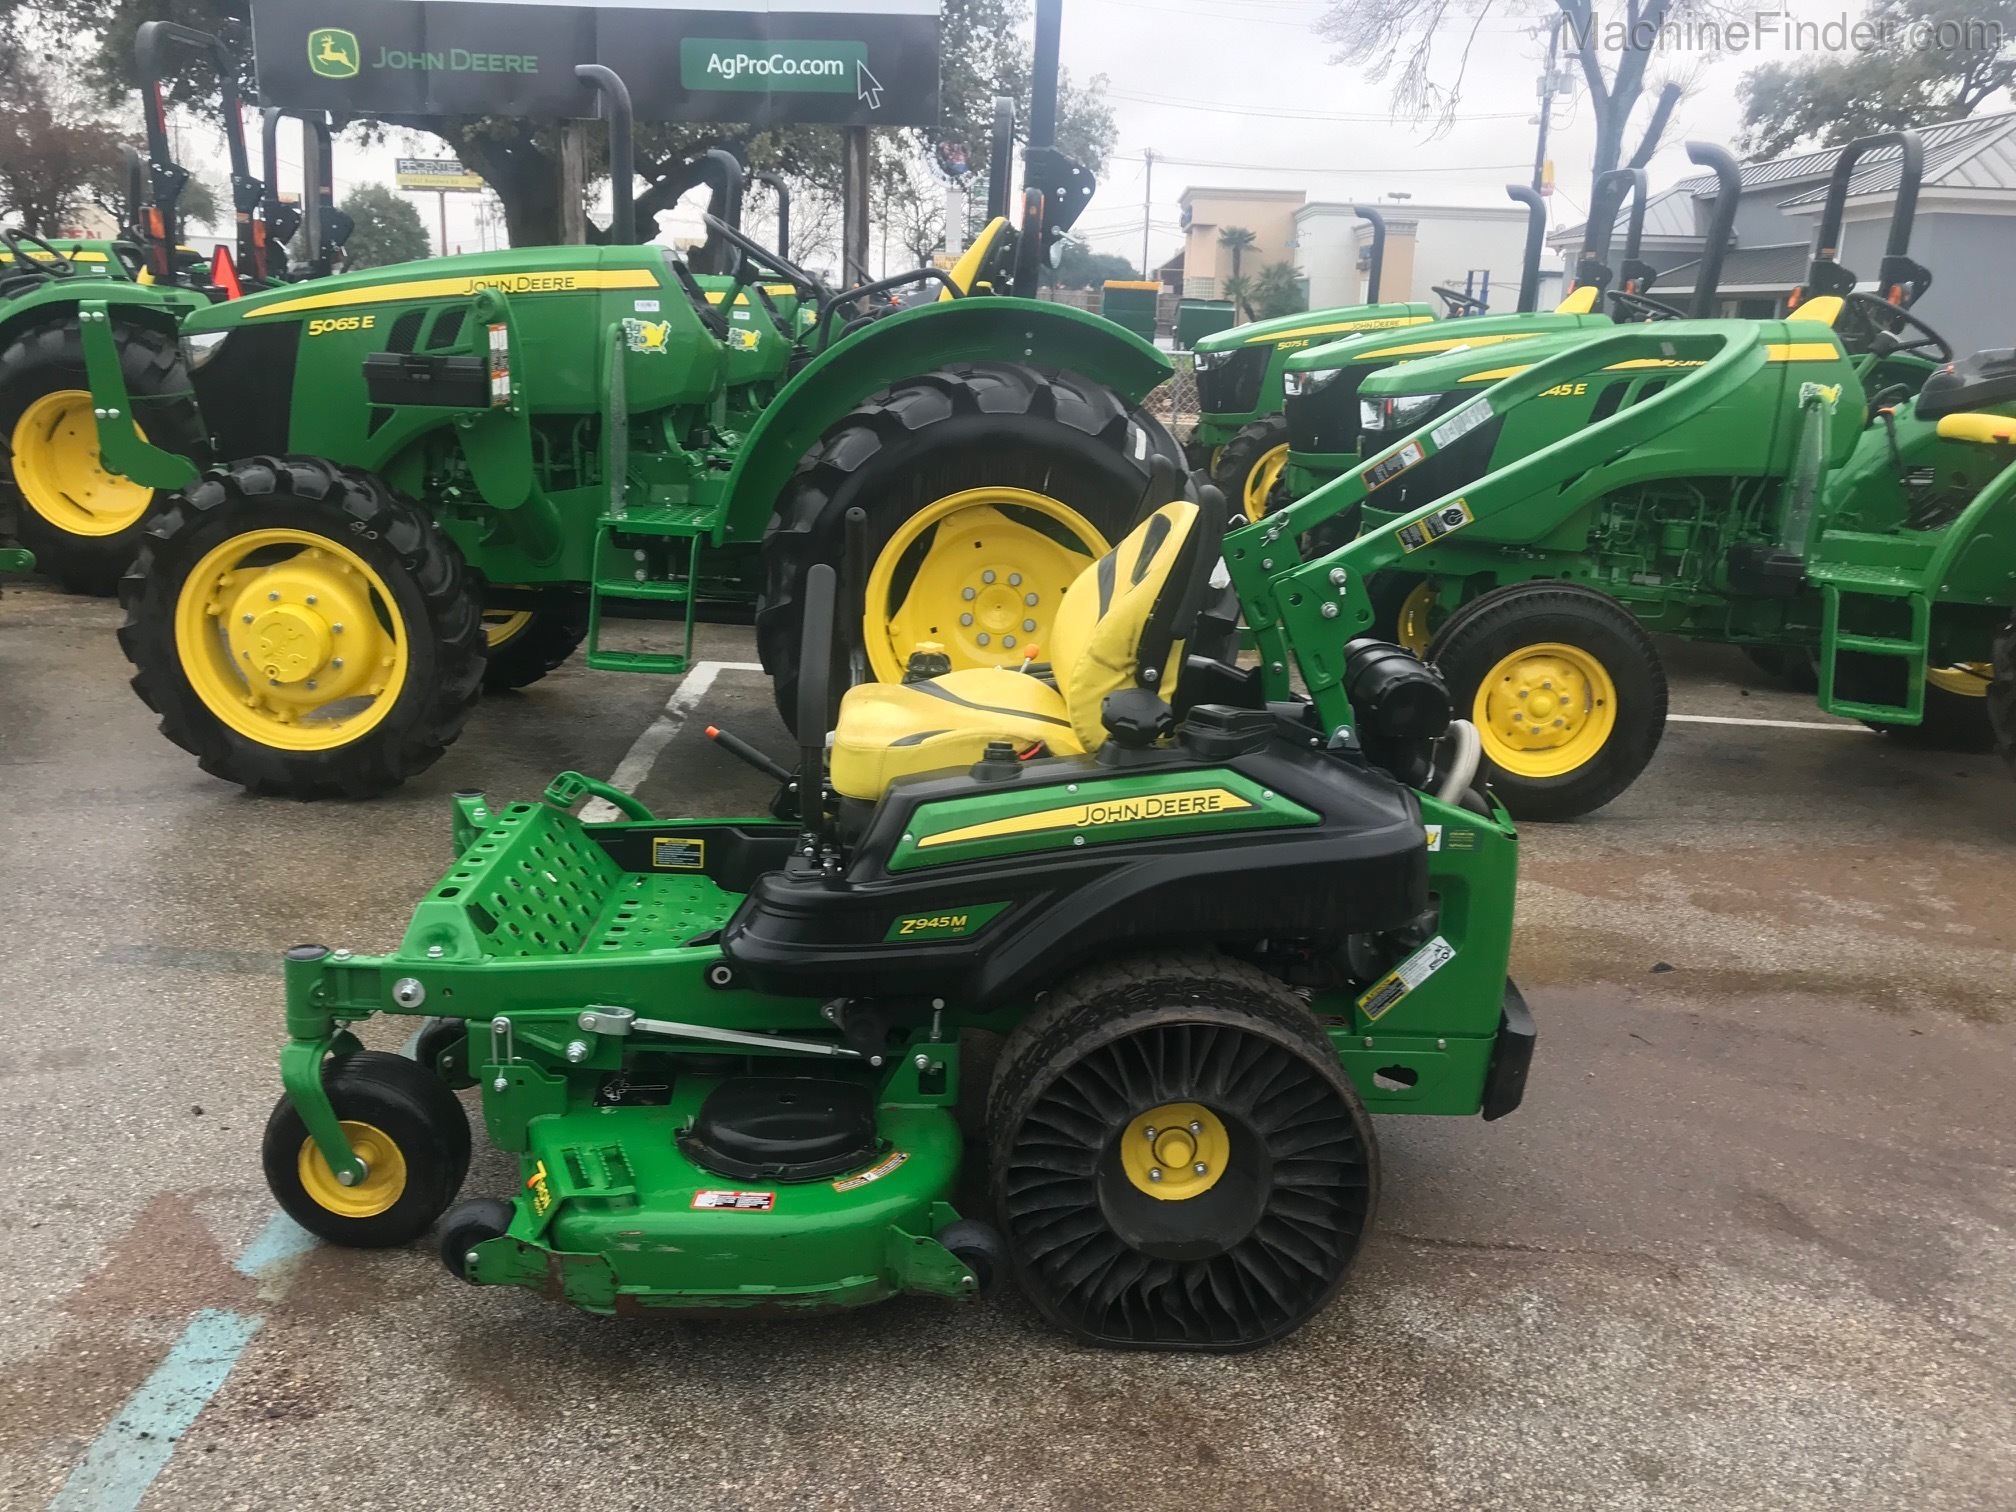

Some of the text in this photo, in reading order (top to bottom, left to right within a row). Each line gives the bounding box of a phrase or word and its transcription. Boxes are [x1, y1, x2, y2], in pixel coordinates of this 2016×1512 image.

[372, 46, 539, 74] JOHN DEERE
[706, 53, 845, 79] AgProCo.com
[516, 277, 575, 291] DEERE
[308, 316, 360, 336] 5065
[1374, 320, 1400, 328] DEERE
[1077, 795, 1221, 825] JOHN DEERE
[899, 915, 968, 934] Z945M
